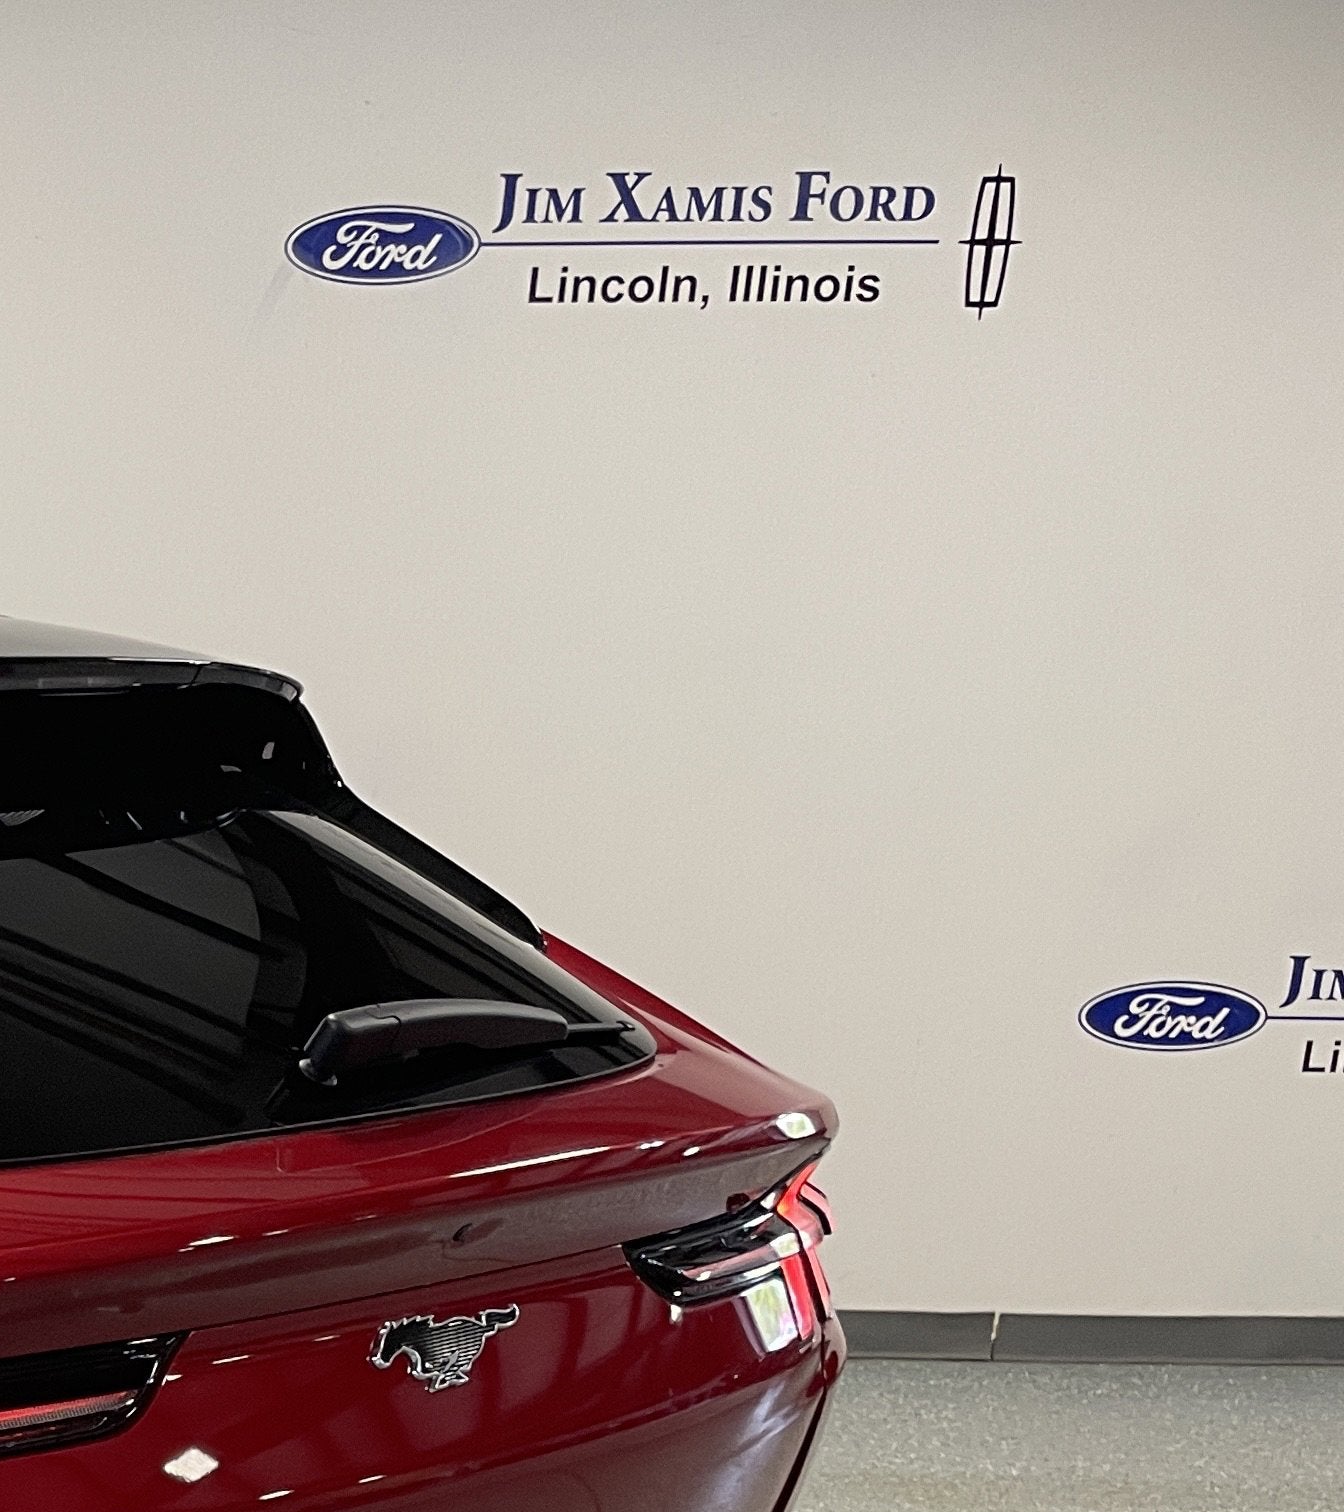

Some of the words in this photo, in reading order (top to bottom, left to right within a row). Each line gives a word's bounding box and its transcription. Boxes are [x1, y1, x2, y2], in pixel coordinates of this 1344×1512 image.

[492, 173, 587, 234] JIM
[600, 171, 774, 224] XAMIS
[788, 171, 937, 224] FORD
[322, 221, 438, 273] Ford
[528, 265, 711, 310] Lincoln,
[728, 265, 881, 303] Illinois
[1113, 993, 1231, 1040] Ford
